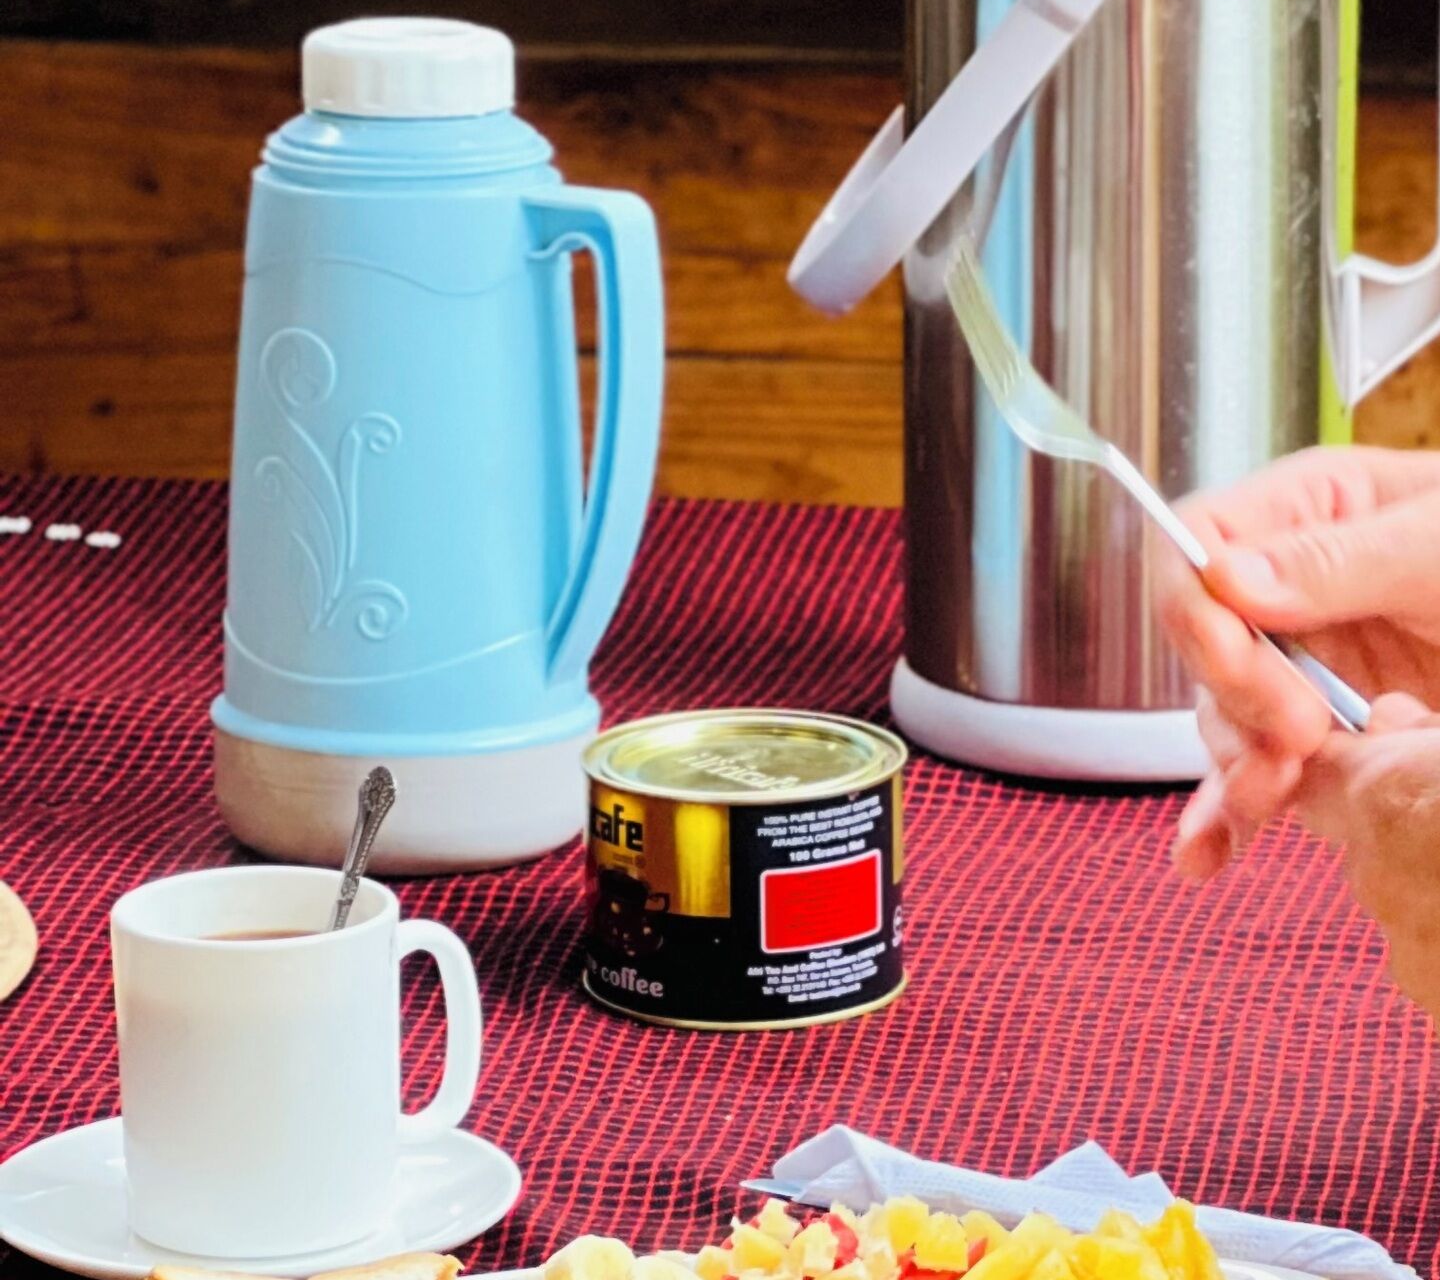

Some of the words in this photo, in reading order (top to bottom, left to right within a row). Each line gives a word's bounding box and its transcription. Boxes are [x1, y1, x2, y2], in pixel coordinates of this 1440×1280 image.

[789, 813, 816, 822] PURE
[757, 828, 787, 837] FROM
[789, 825, 808, 834] THE
[809, 821, 833, 832] BEST
[771, 836, 814, 848] ARABICA
[815, 829, 849, 843] COFFEE
[601, 966, 664, 997] coffee
